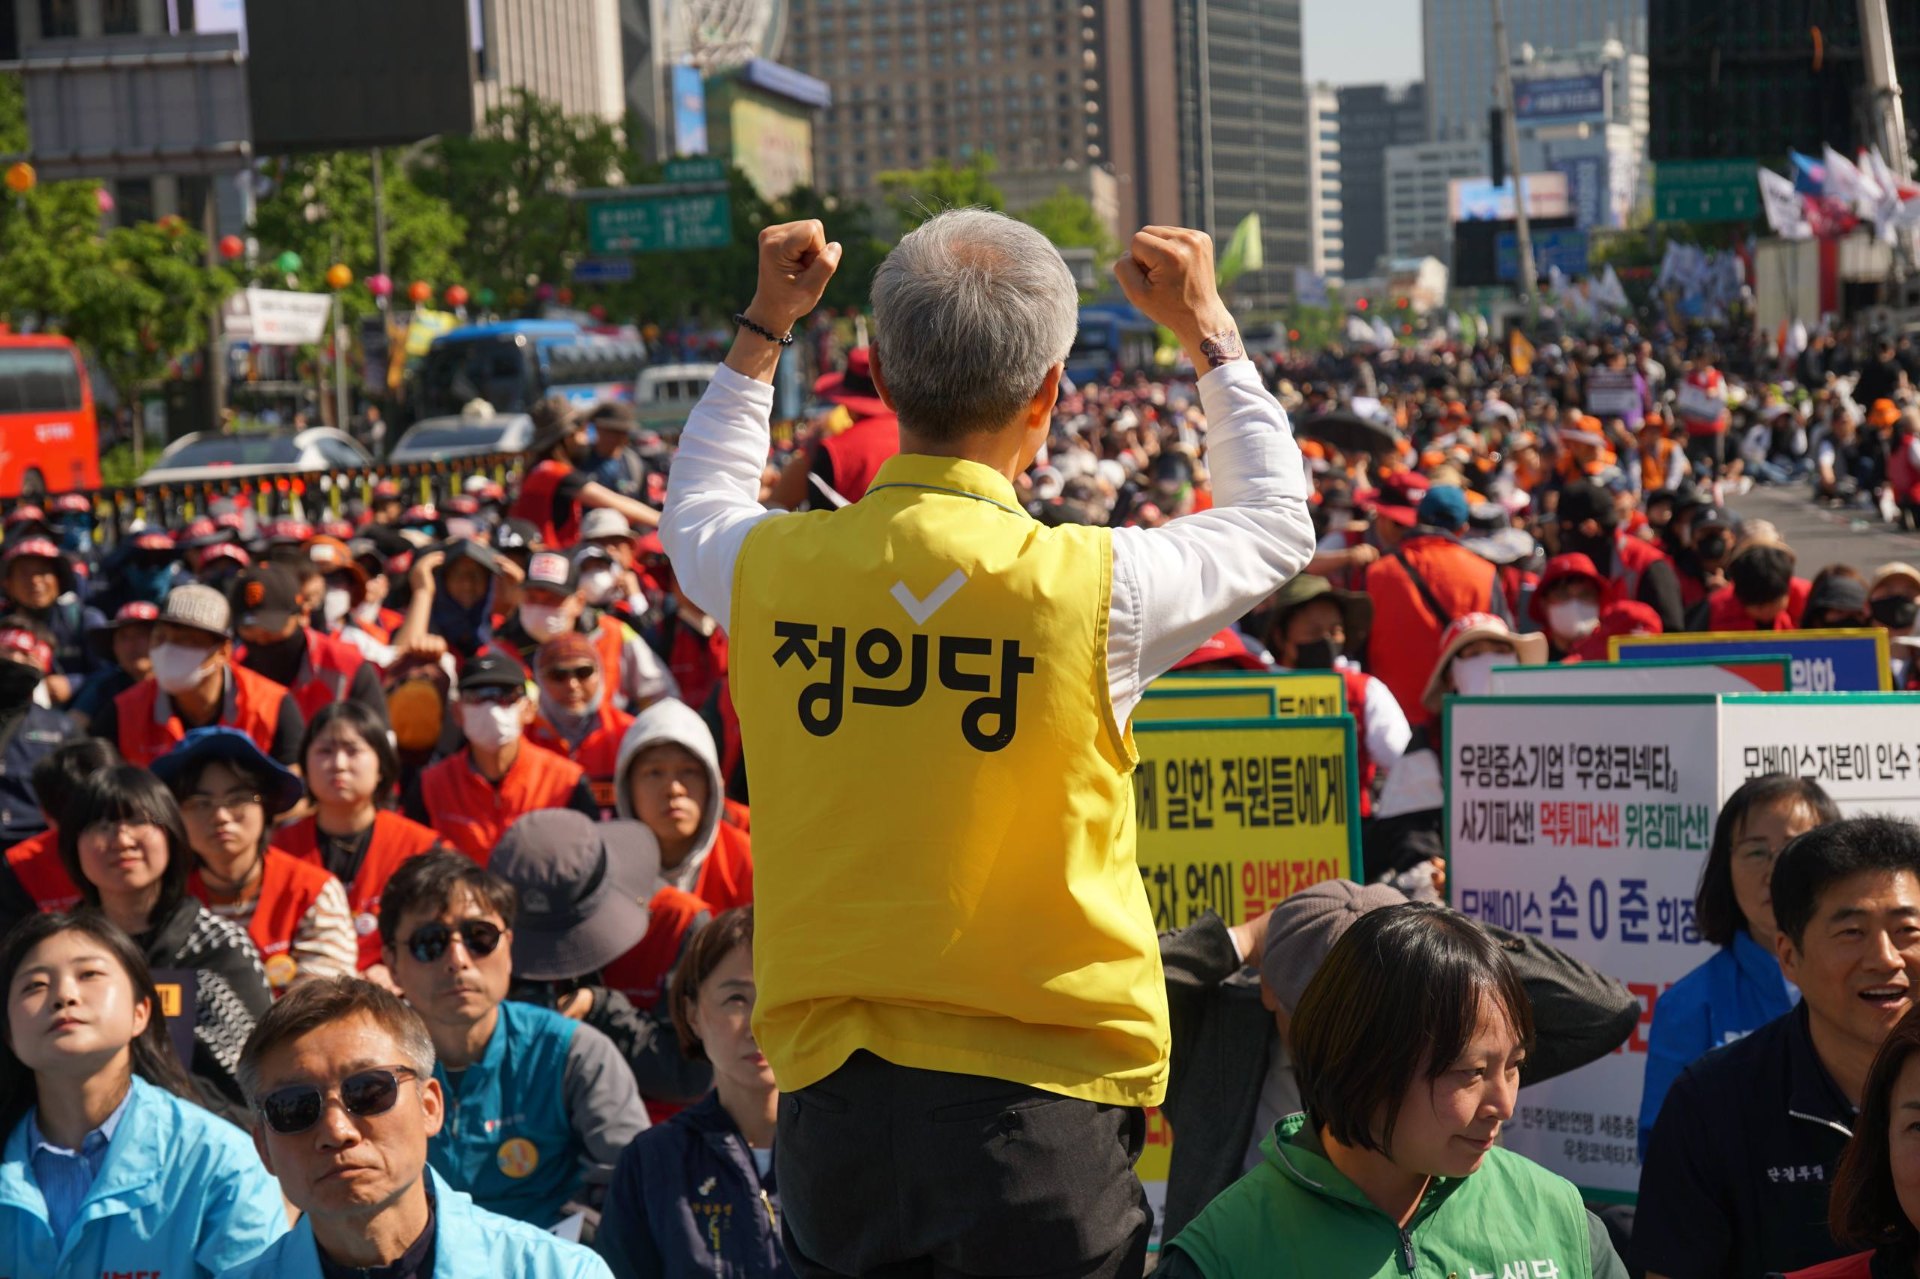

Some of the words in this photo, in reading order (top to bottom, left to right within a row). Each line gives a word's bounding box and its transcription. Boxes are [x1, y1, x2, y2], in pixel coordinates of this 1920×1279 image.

[772, 620, 1034, 752] 정의당
[1460, 745, 1564, 789] 우량중소기업
[1744, 744, 1870, 781] 모베이스자본이
[1877, 743, 1911, 780] 인수
[1165, 757, 1214, 829] 일한
[1221, 754, 1345, 827] 직원들에게
[1459, 801, 1535, 844] 사기파산!
[1540, 802, 1619, 848] 먹튀파산!
[1625, 803, 1709, 851] 위장파산!
[1461, 889, 1543, 935] 모베이스
